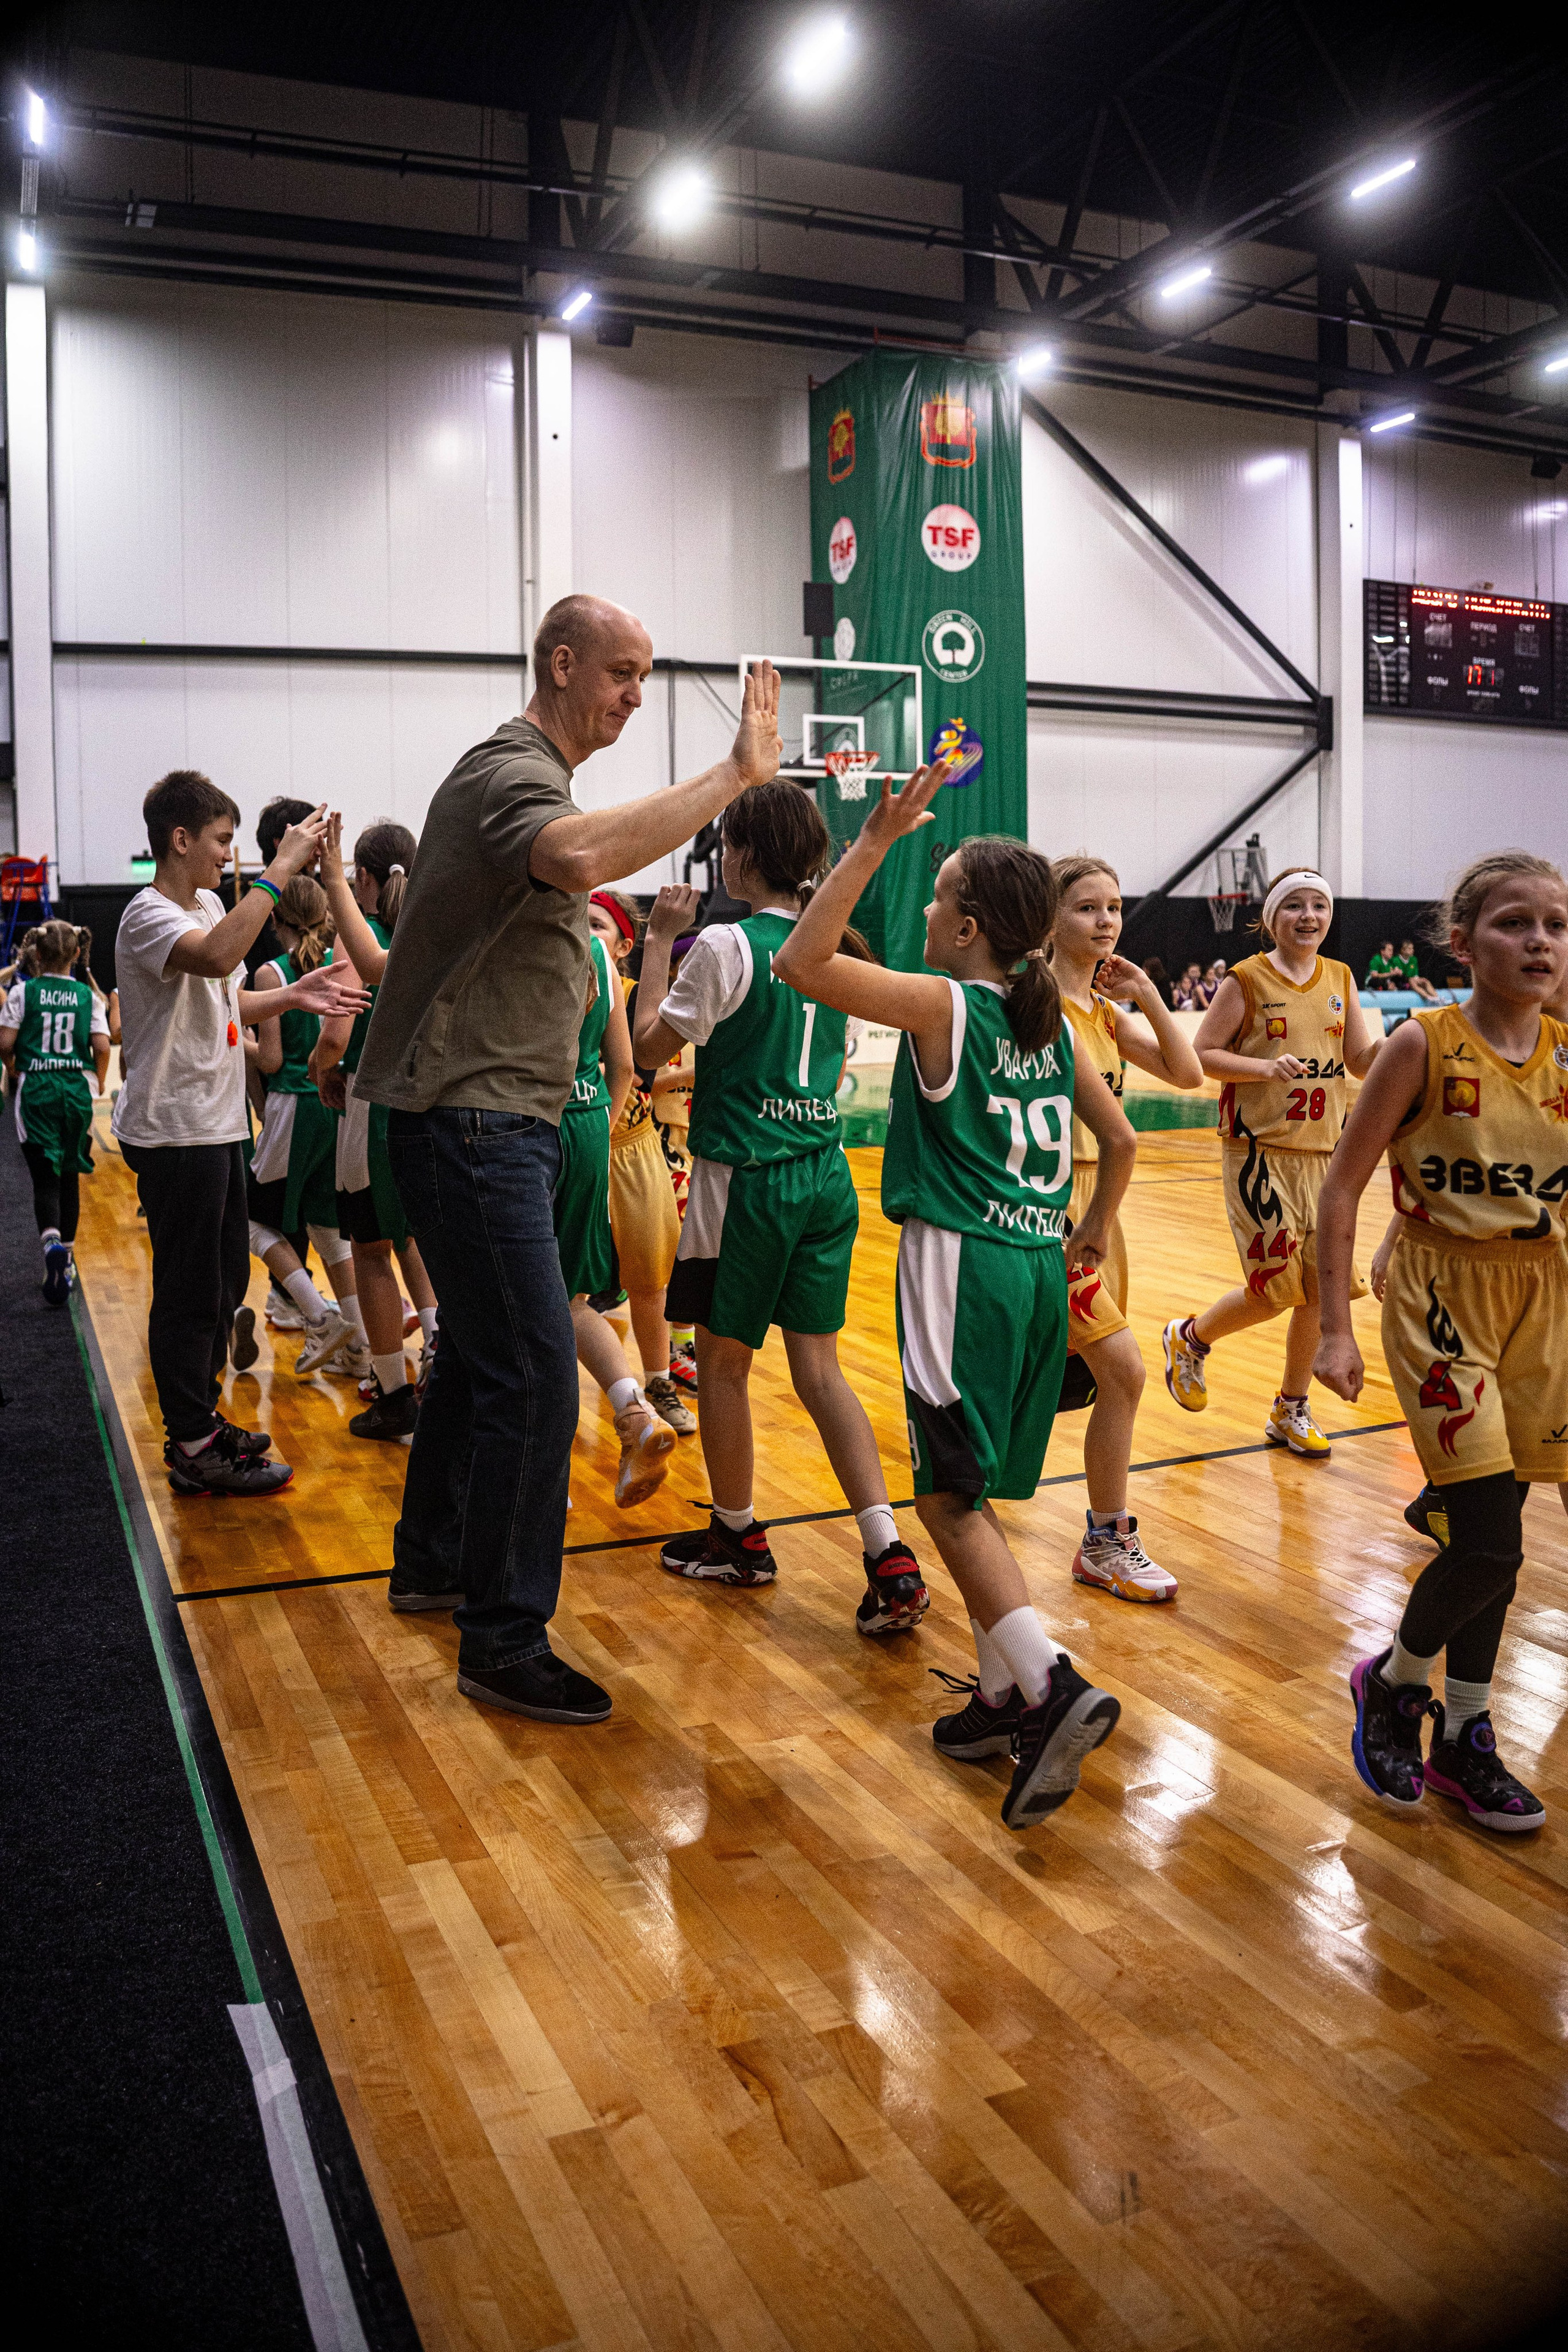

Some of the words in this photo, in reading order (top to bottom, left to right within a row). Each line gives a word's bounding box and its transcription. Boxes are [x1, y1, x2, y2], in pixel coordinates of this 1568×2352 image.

[831, 535, 854, 562] TSF
[927, 526, 974, 548] TSF
[39, 989, 78, 1008] ВАСИНА
[40, 1011, 76, 1055] 18
[798, 1003, 816, 1087] 1
[1285, 1087, 1326, 1121] 28
[986, 1094, 1072, 1194] 79
[1247, 1228, 1289, 1263] 44
